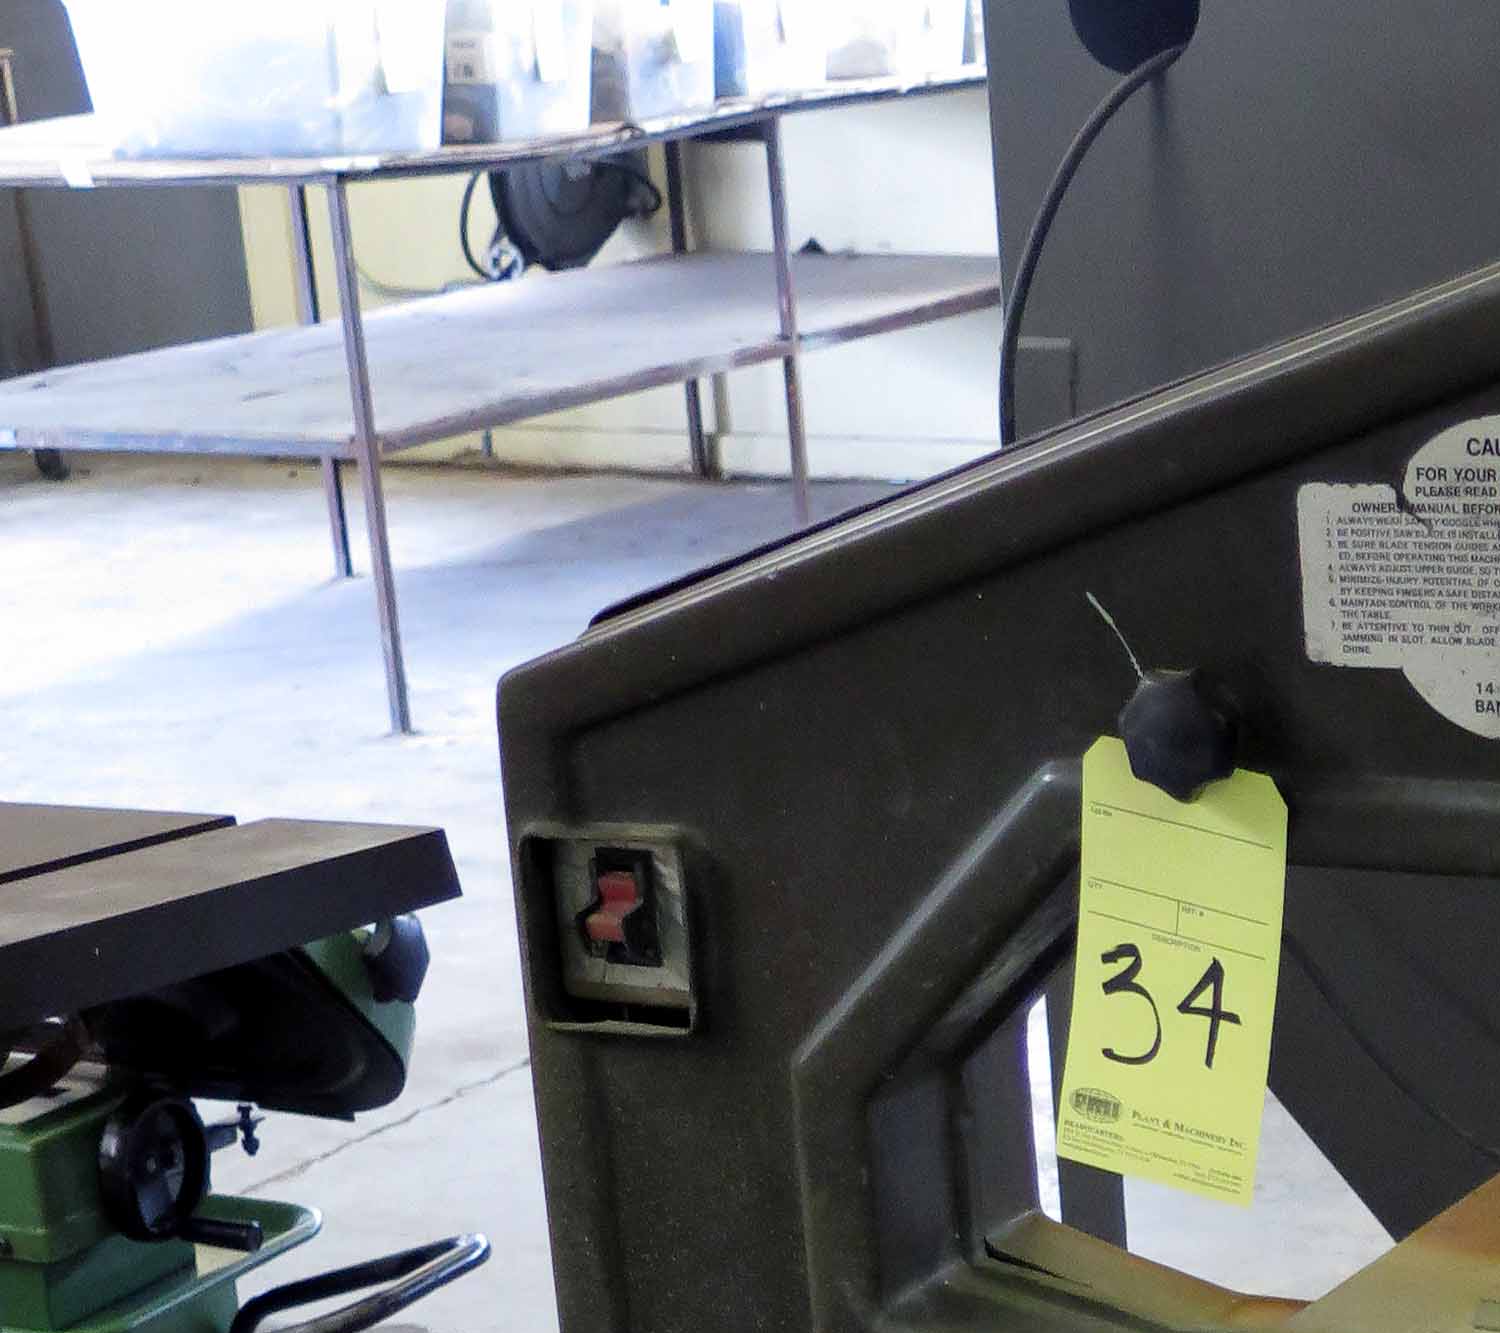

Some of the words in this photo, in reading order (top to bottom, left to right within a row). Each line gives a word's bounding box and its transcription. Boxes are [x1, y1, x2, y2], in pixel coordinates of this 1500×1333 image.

[1415, 466, 1448, 482] FOR
[1453, 467, 1497, 483] YOUR
[1414, 486, 1461, 498] PLEASE
[1463, 486, 1497, 498] READ
[1101, 943, 1242, 1069] 34
